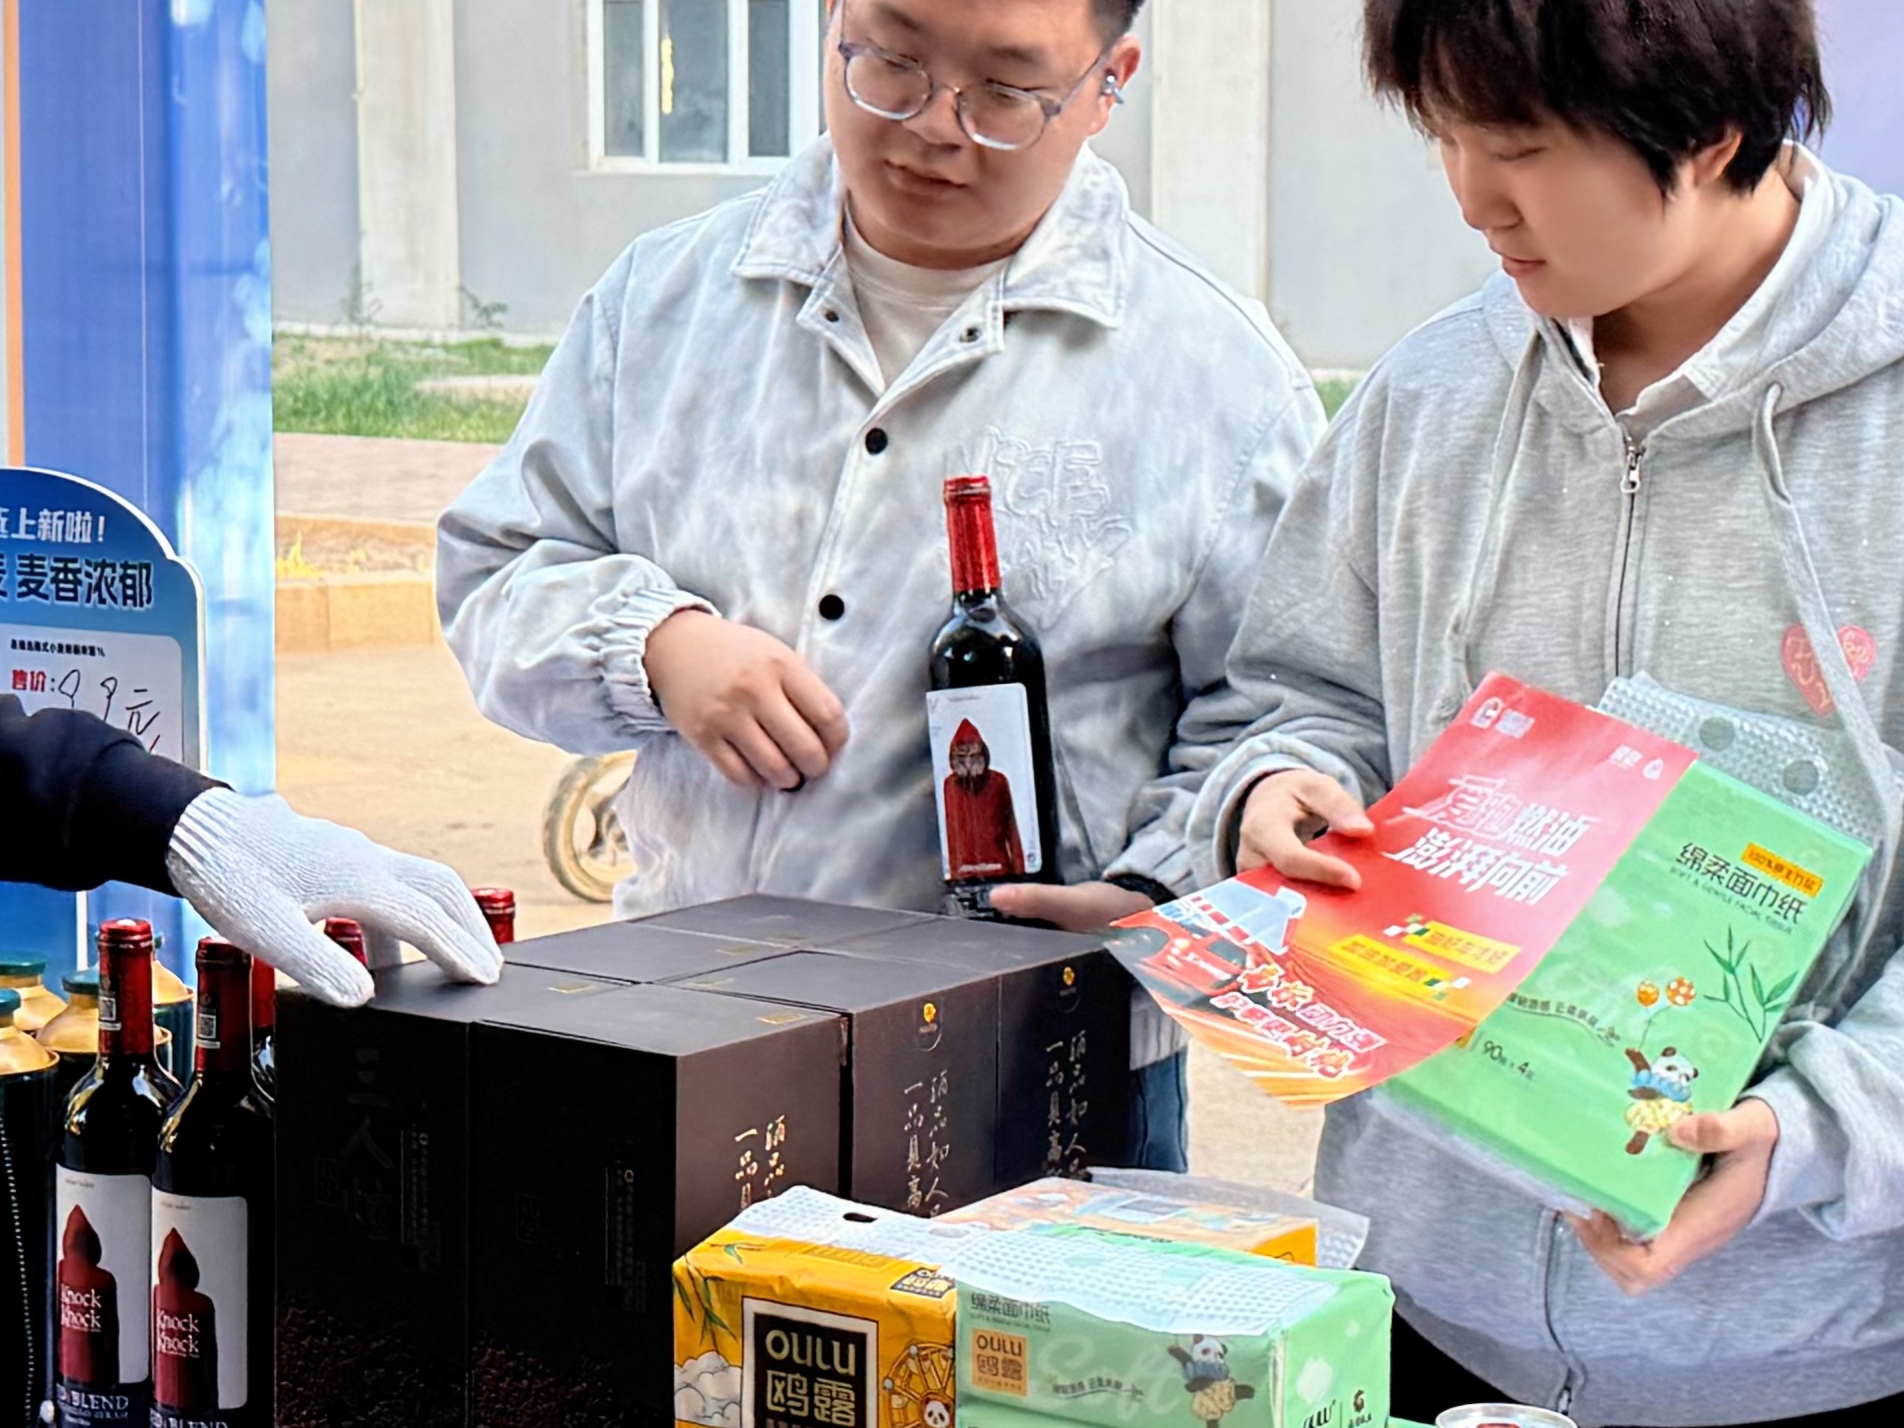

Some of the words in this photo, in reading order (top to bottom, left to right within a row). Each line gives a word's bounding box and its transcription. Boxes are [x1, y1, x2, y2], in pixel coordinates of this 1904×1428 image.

[17, 554, 153, 609] 麦香浓郁
[1676, 841, 1808, 925] 绵柔面巾纸
[60, 1283, 102, 1309] Knock
[60, 1304, 102, 1330] Knock
[156, 1309, 201, 1333] Knock
[156, 1332, 200, 1356] Knock
[765, 1329, 856, 1377] OULU
[976, 1334, 1023, 1357] OULU
[72, 1389, 130, 1411] BLEND
[766, 1370, 856, 1427] 鸥露
